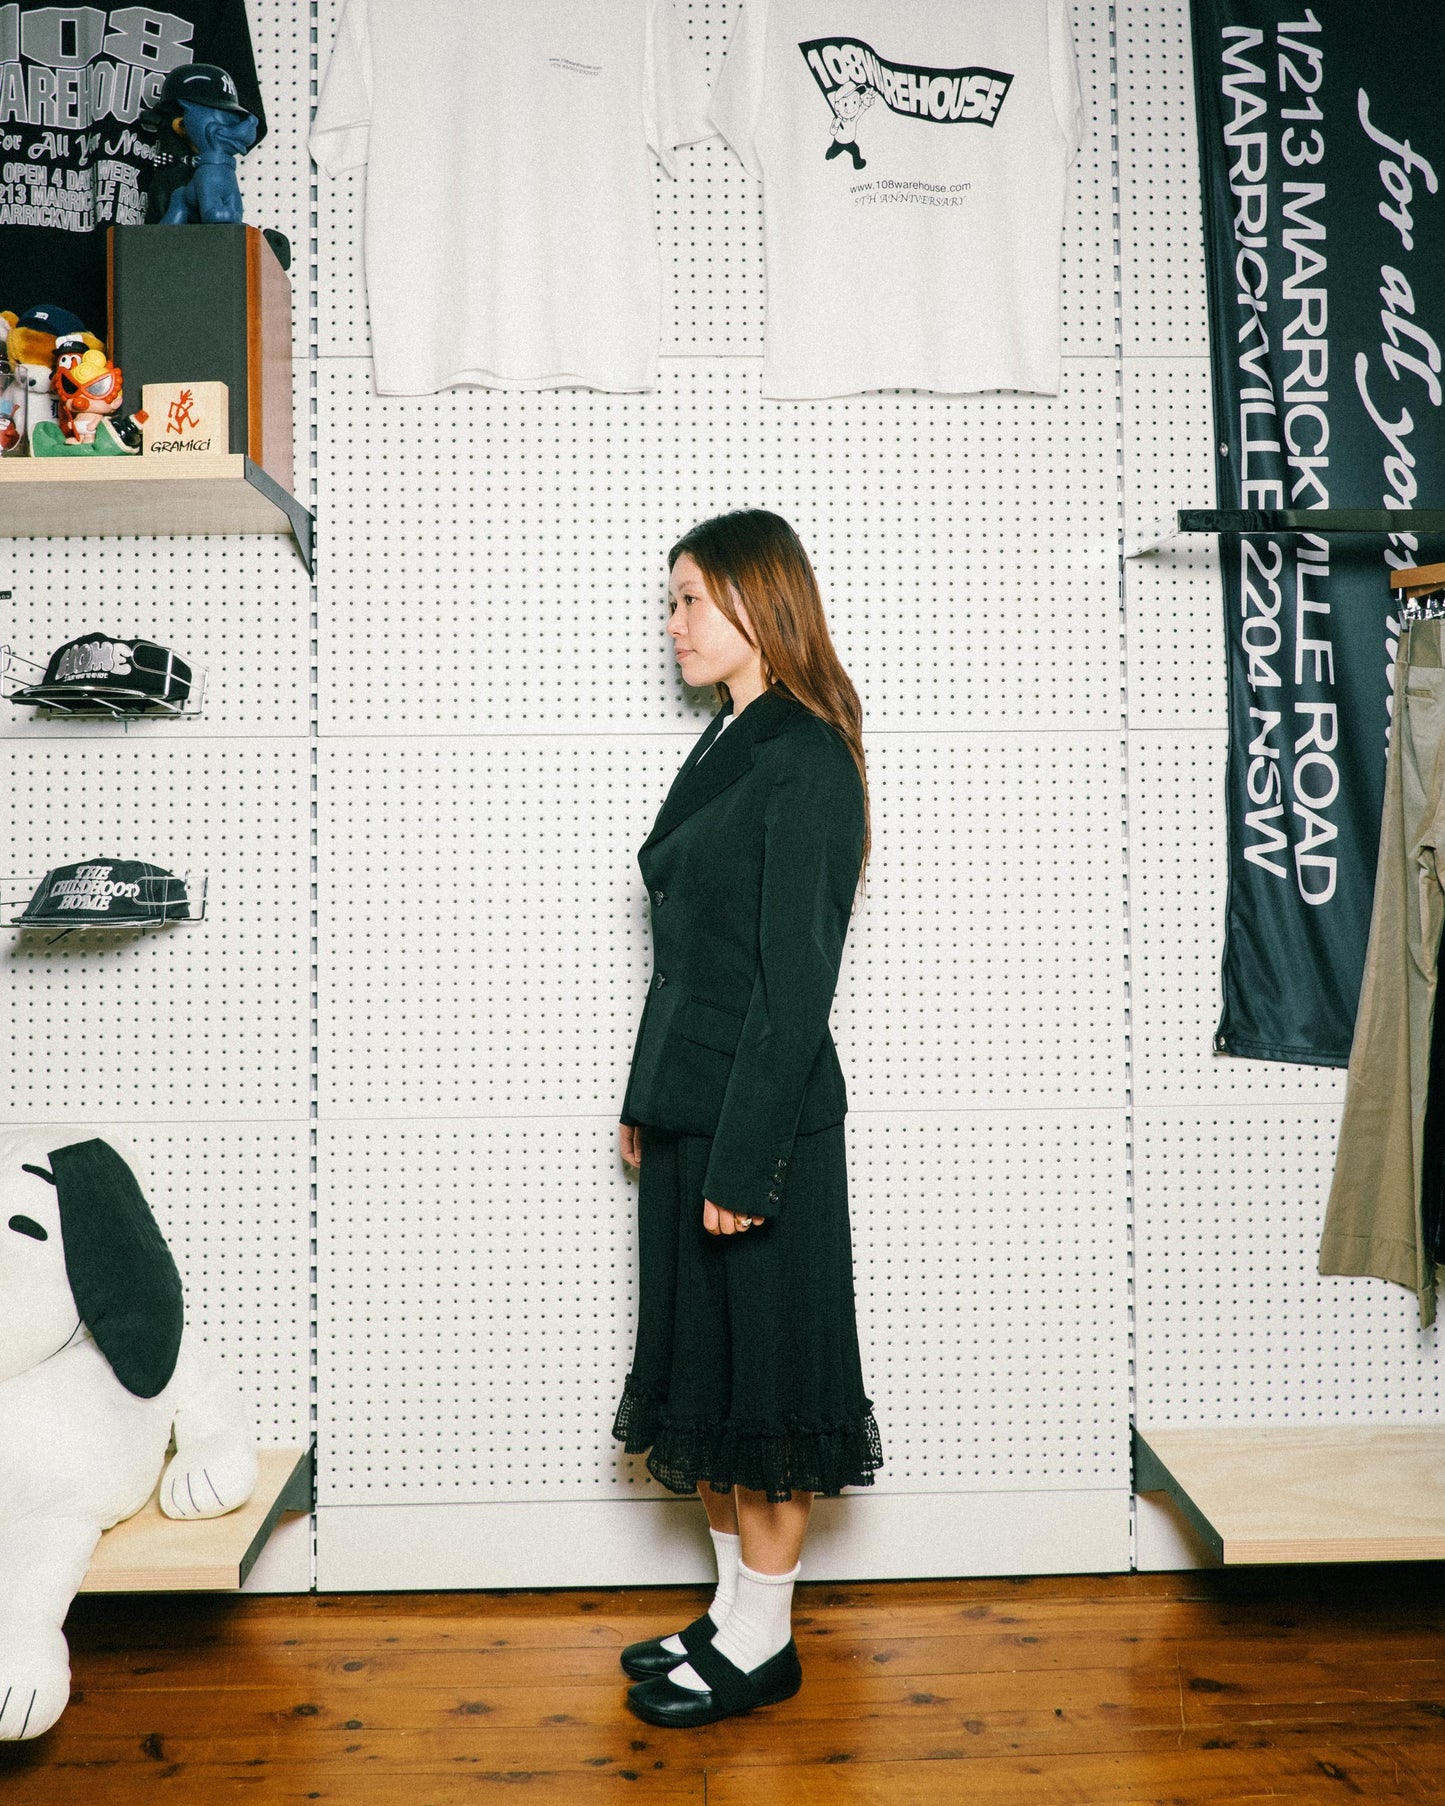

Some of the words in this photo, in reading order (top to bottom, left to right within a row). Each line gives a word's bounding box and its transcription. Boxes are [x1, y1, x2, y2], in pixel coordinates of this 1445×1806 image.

[1277, 8, 1324, 166] 1/213
[3, 162, 48, 186] OPEN
[51, 168, 63, 188] 4
[97, 160, 141, 189] WEEK
[28, 131, 70, 160] All
[849, 179, 972, 194] www.108warehouse.com
[1357, 87, 1438, 250] for
[0, 204, 95, 232] ARRICKVILLE
[880, 192, 967, 207] ANNIVERSARY
[1221, 26, 1283, 509] MARRICKVILLE
[1379, 265, 1442, 406] all
[1241, 539, 1283, 693] 2204
[1243, 707, 1288, 880] NSW
[1293, 702, 1340, 906] ROAD
[57, 895, 113, 911] HOME
[75, 865, 113, 880] THE
